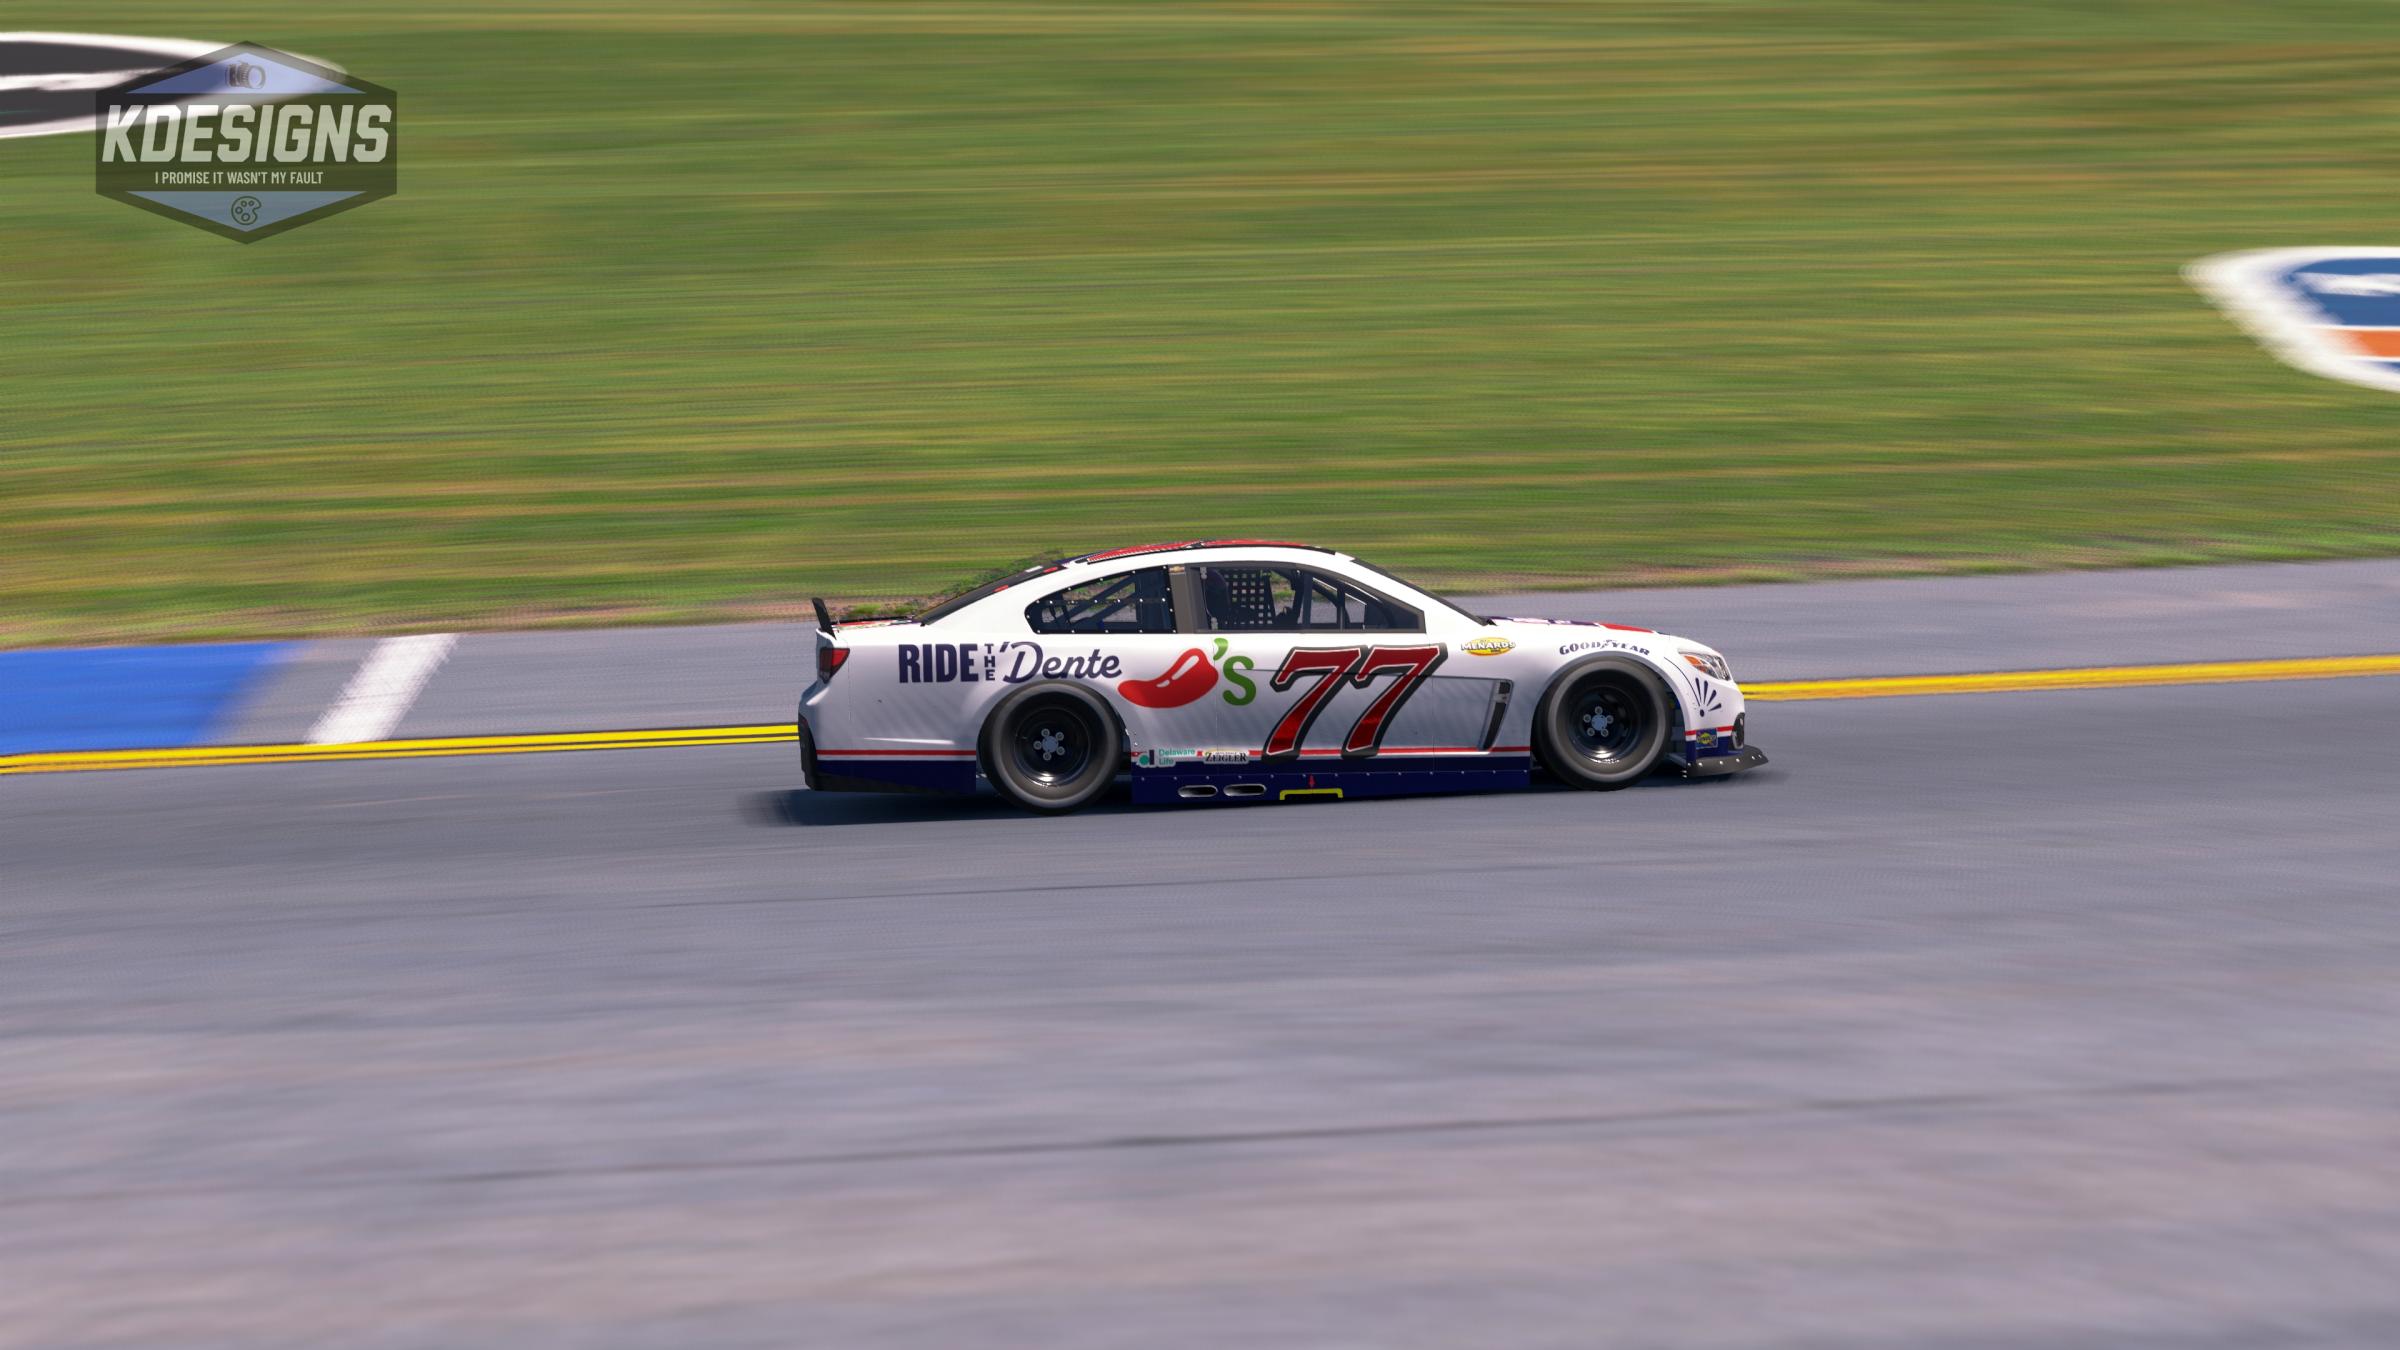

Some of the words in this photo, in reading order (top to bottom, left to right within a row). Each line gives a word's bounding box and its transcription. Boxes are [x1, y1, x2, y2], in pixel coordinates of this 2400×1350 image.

[899, 643, 979, 683] RIDE
[984, 643, 996, 681] THE
[1461, 641, 1516, 651] MENARDS
[1261, 642, 1449, 764] 77
